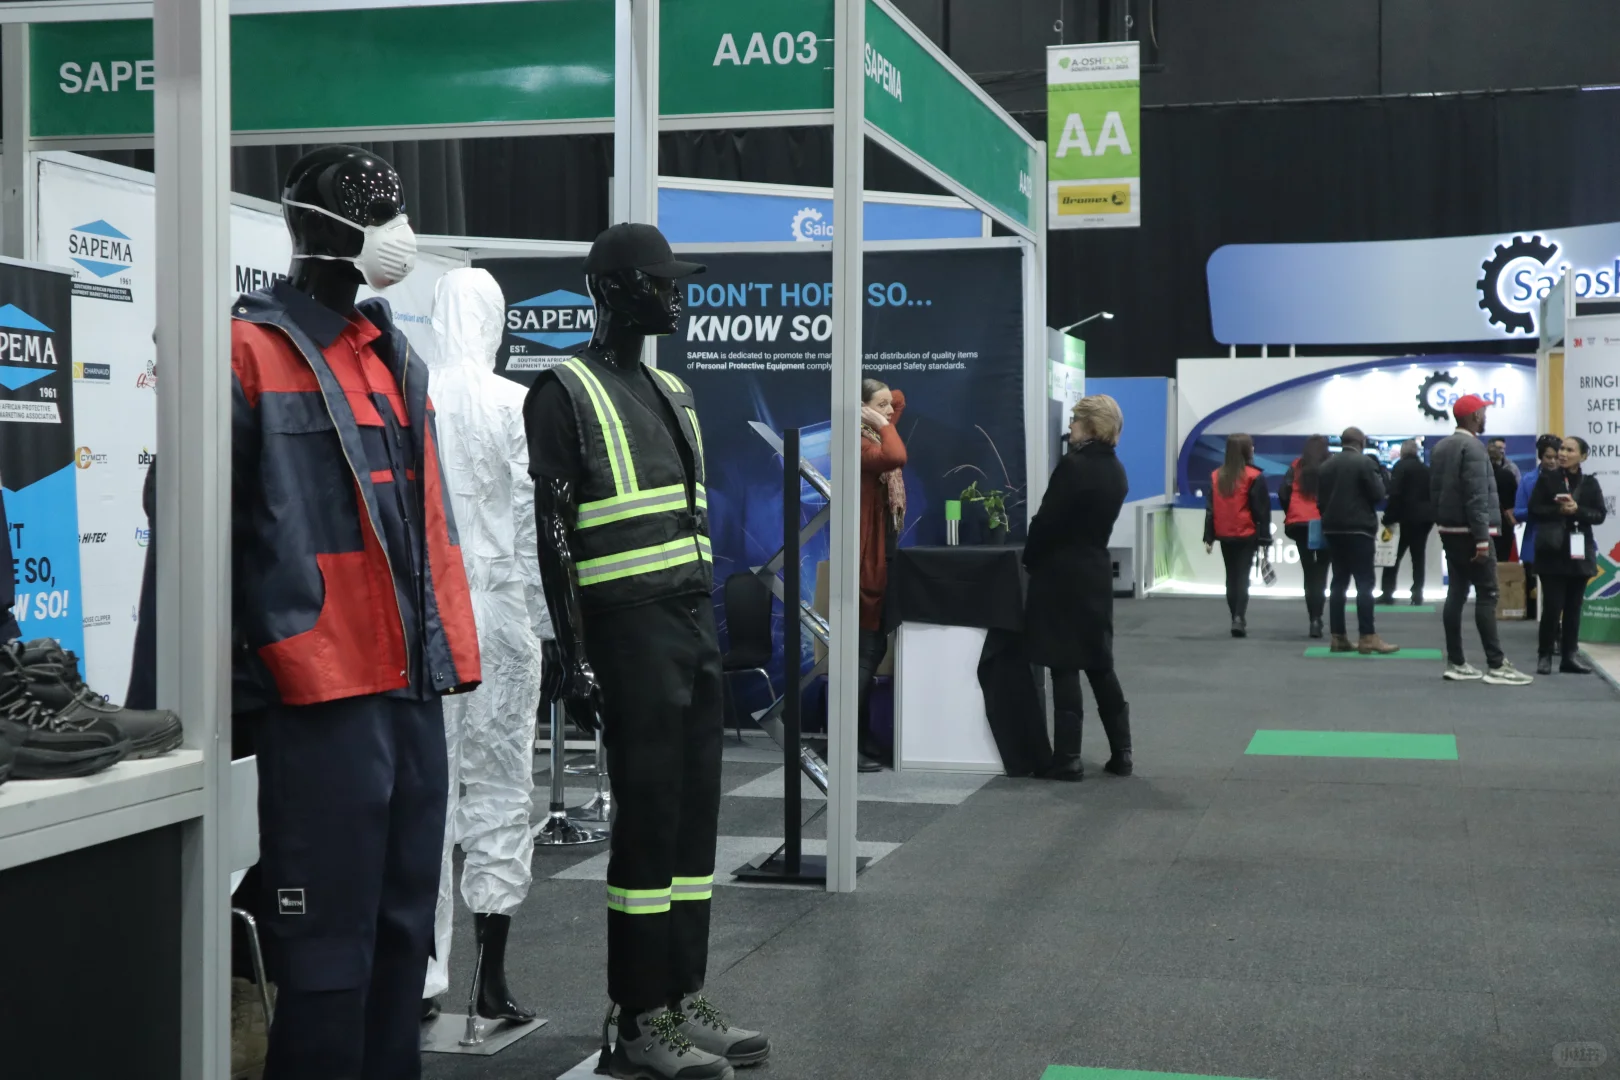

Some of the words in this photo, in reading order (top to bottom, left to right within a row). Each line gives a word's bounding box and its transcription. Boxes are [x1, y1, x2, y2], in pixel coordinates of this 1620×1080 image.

[712, 30, 818, 66] AA03
[59, 60, 154, 94] SAPE
[864, 42, 902, 103] SAPEMA
[1055, 110, 1133, 158] AA
[68, 233, 133, 263] SAPEMA
[119, 277, 132, 286] 1961
[687, 282, 773, 307] DON'T
[867, 282, 933, 307] SO...
[686, 314, 784, 342] KNOW
[790, 314, 833, 342] SO
[0, 332, 58, 364] PEMA
[1573, 337, 1584, 348] 3M
[509, 345, 528, 353] EST.
[773, 353, 803, 361] promote
[864, 352, 879, 360] and
[880, 351, 921, 360] distribution
[922, 351, 930, 359] of
[932, 351, 956, 361] quality
[957, 350, 979, 359] items
[83, 367, 110, 376] CHARNAUD
[766, 362, 805, 371] Equipment
[806, 362, 833, 371] comply
[862, 362, 902, 372] recognised
[903, 362, 926, 372] Safety
[928, 361, 967, 370] standards.
[1580, 375, 1619, 389] BRINGI
[38, 387, 57, 398] 1961
[2, 402, 21, 411] AFRICAN
[22, 403, 51, 412] PROTECTIVE
[26, 412, 57, 420] ASSOCIATION
[1588, 421, 1603, 435] TO
[82, 532, 106, 544] HI-TEC
[25, 556, 55, 587] SO,
[34, 590, 70, 620] SO!
[94, 614, 111, 622] CLIPPER
